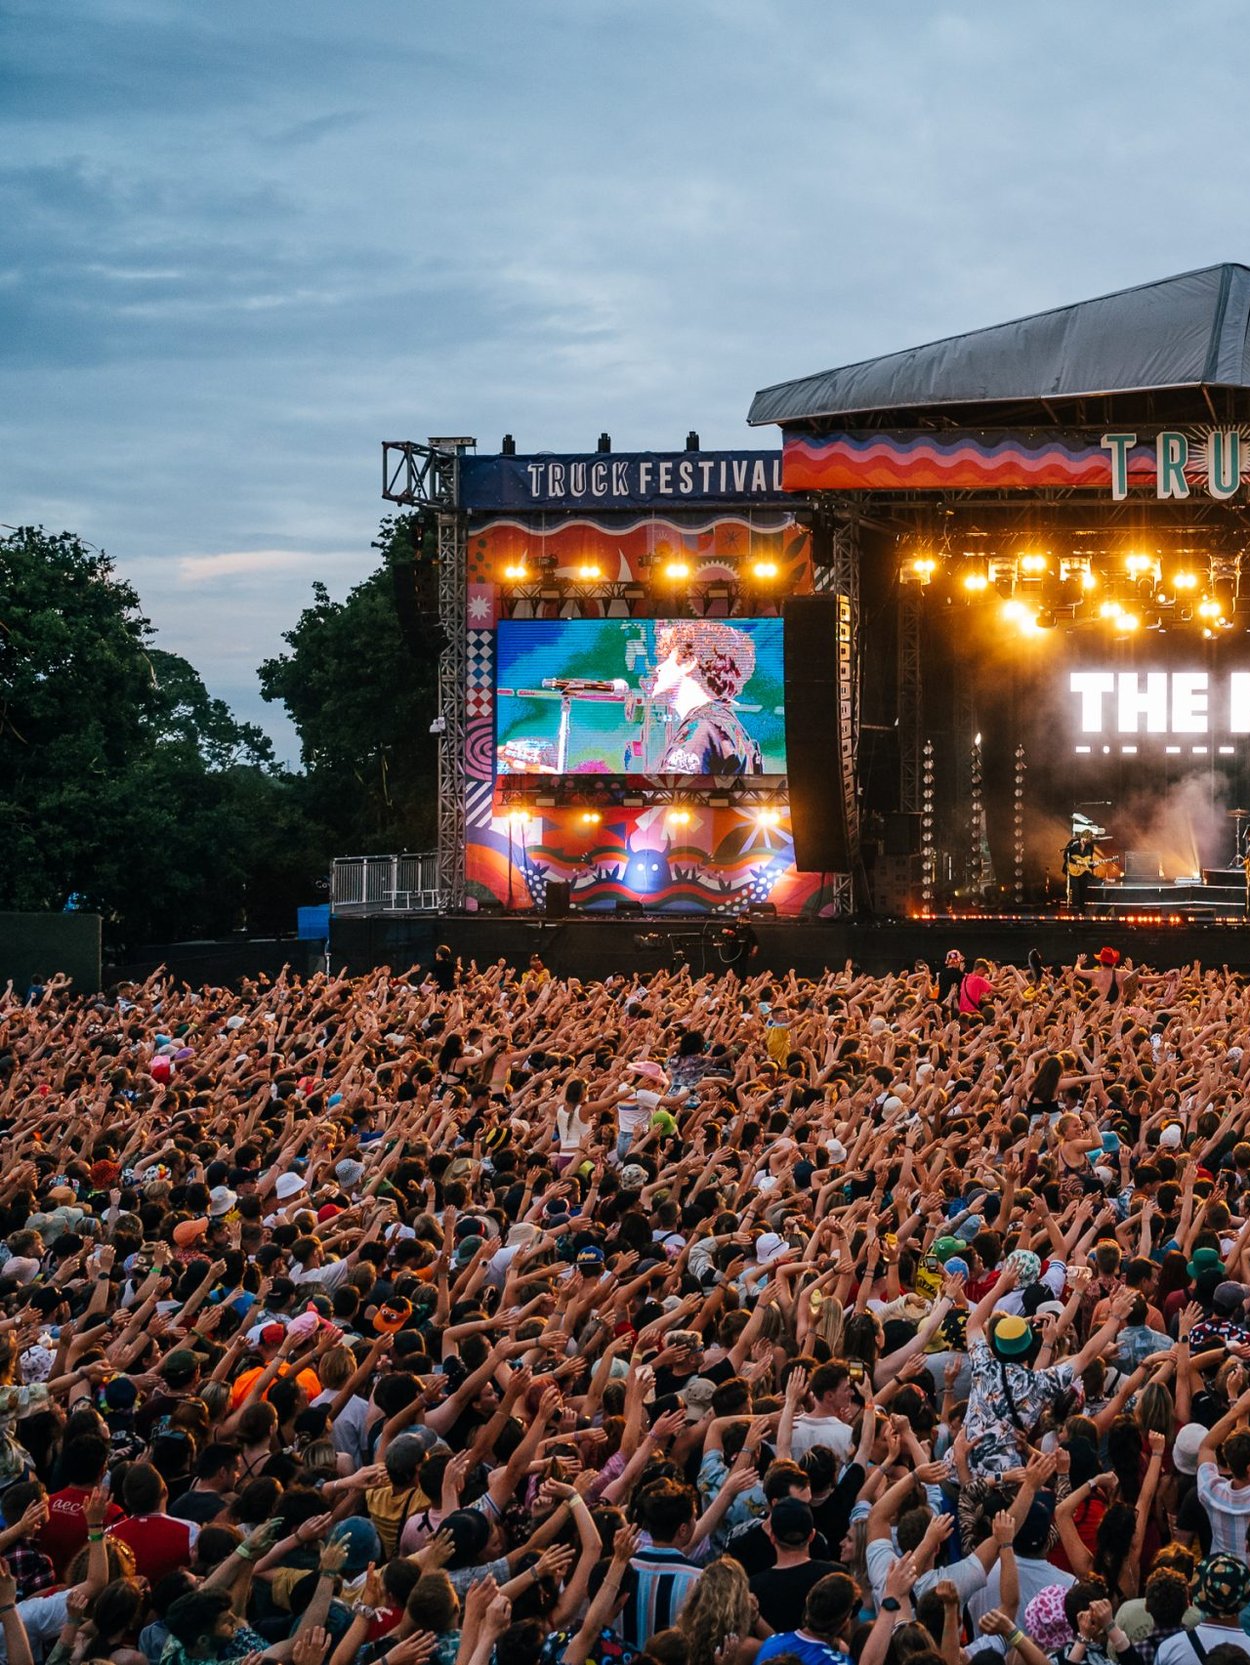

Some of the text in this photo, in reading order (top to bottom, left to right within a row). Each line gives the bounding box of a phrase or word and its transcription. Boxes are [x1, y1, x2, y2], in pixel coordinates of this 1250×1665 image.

[528, 459, 783, 498] TRUCK FESTIVAL
[1070, 671, 1209, 733] THE
